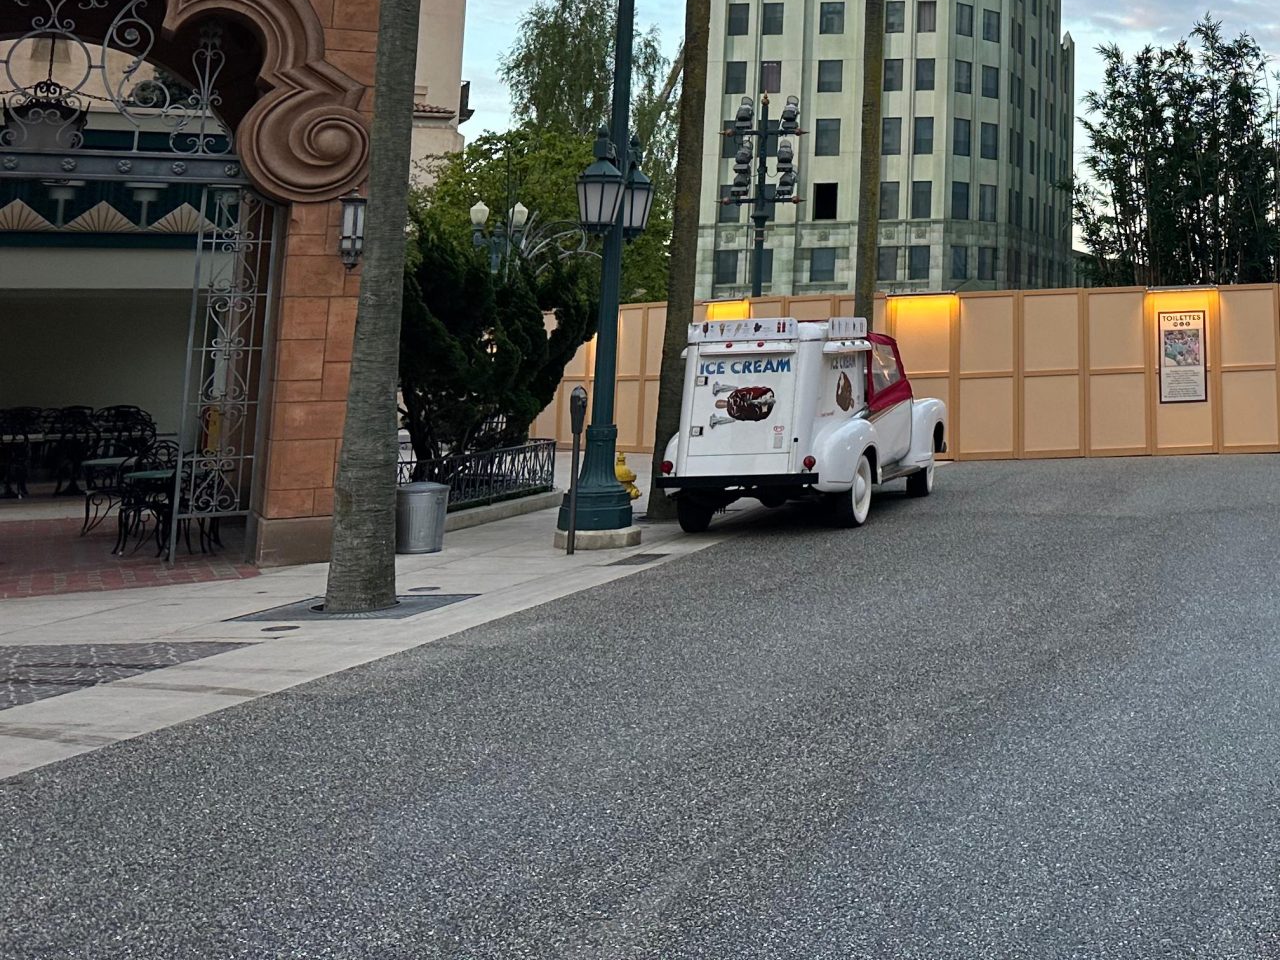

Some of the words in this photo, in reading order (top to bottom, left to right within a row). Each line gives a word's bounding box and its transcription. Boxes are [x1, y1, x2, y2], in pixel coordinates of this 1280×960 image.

[1162, 314, 1201, 322] TOILETTES
[700, 361, 725, 375] ICE
[730, 358, 791, 375] CREAM
